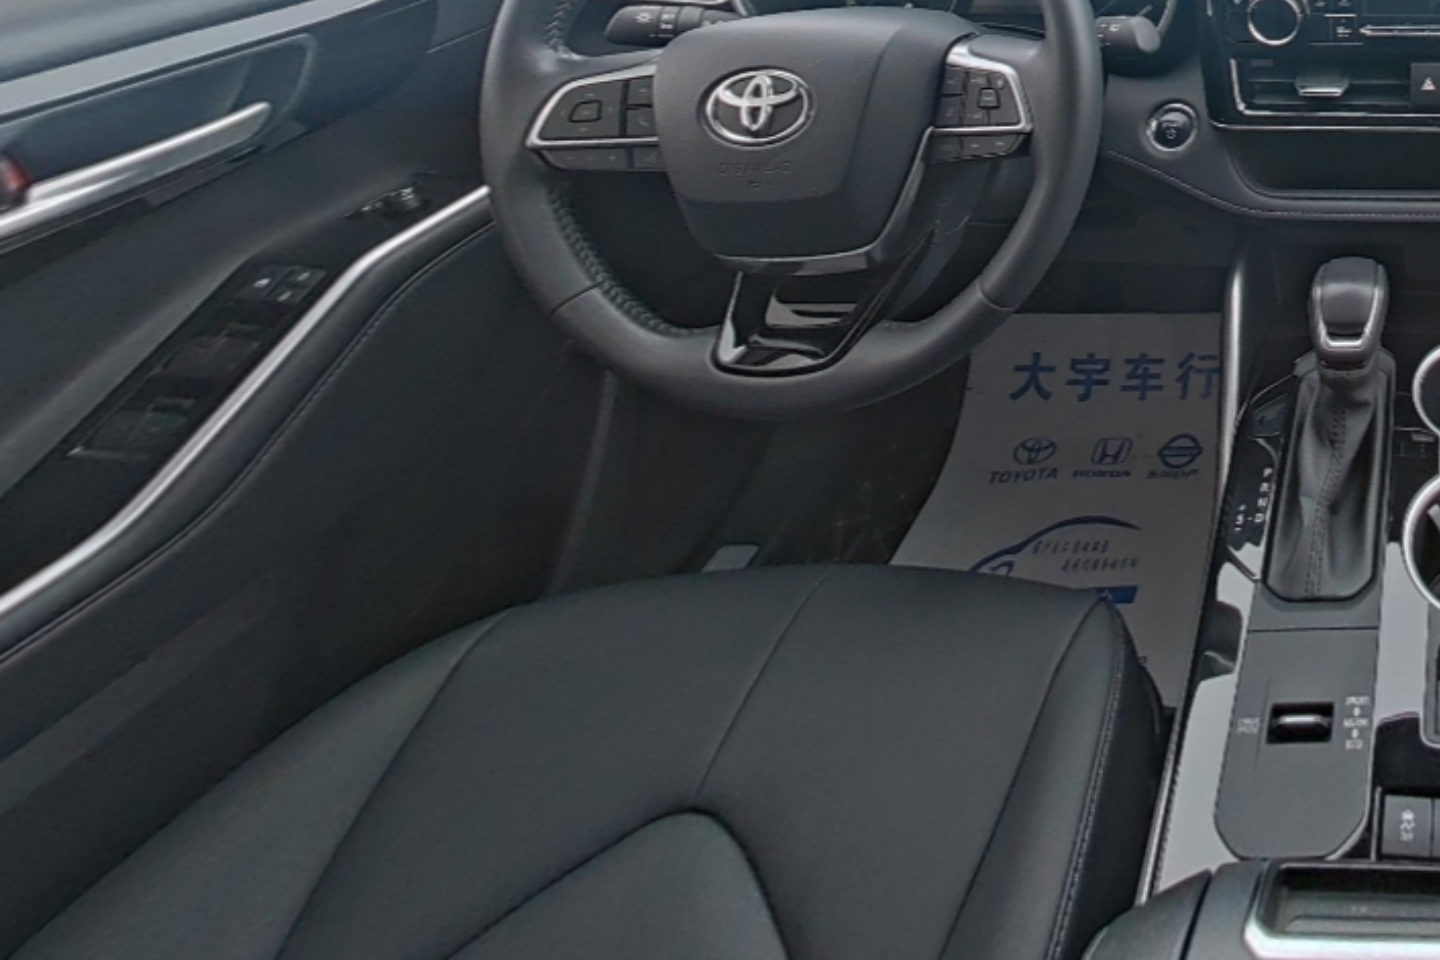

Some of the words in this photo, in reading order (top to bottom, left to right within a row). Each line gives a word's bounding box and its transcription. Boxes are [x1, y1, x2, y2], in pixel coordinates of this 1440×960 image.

[1010, 352, 1220, 401] 大宇车行
[989, 467, 1058, 483] TOYOTA
